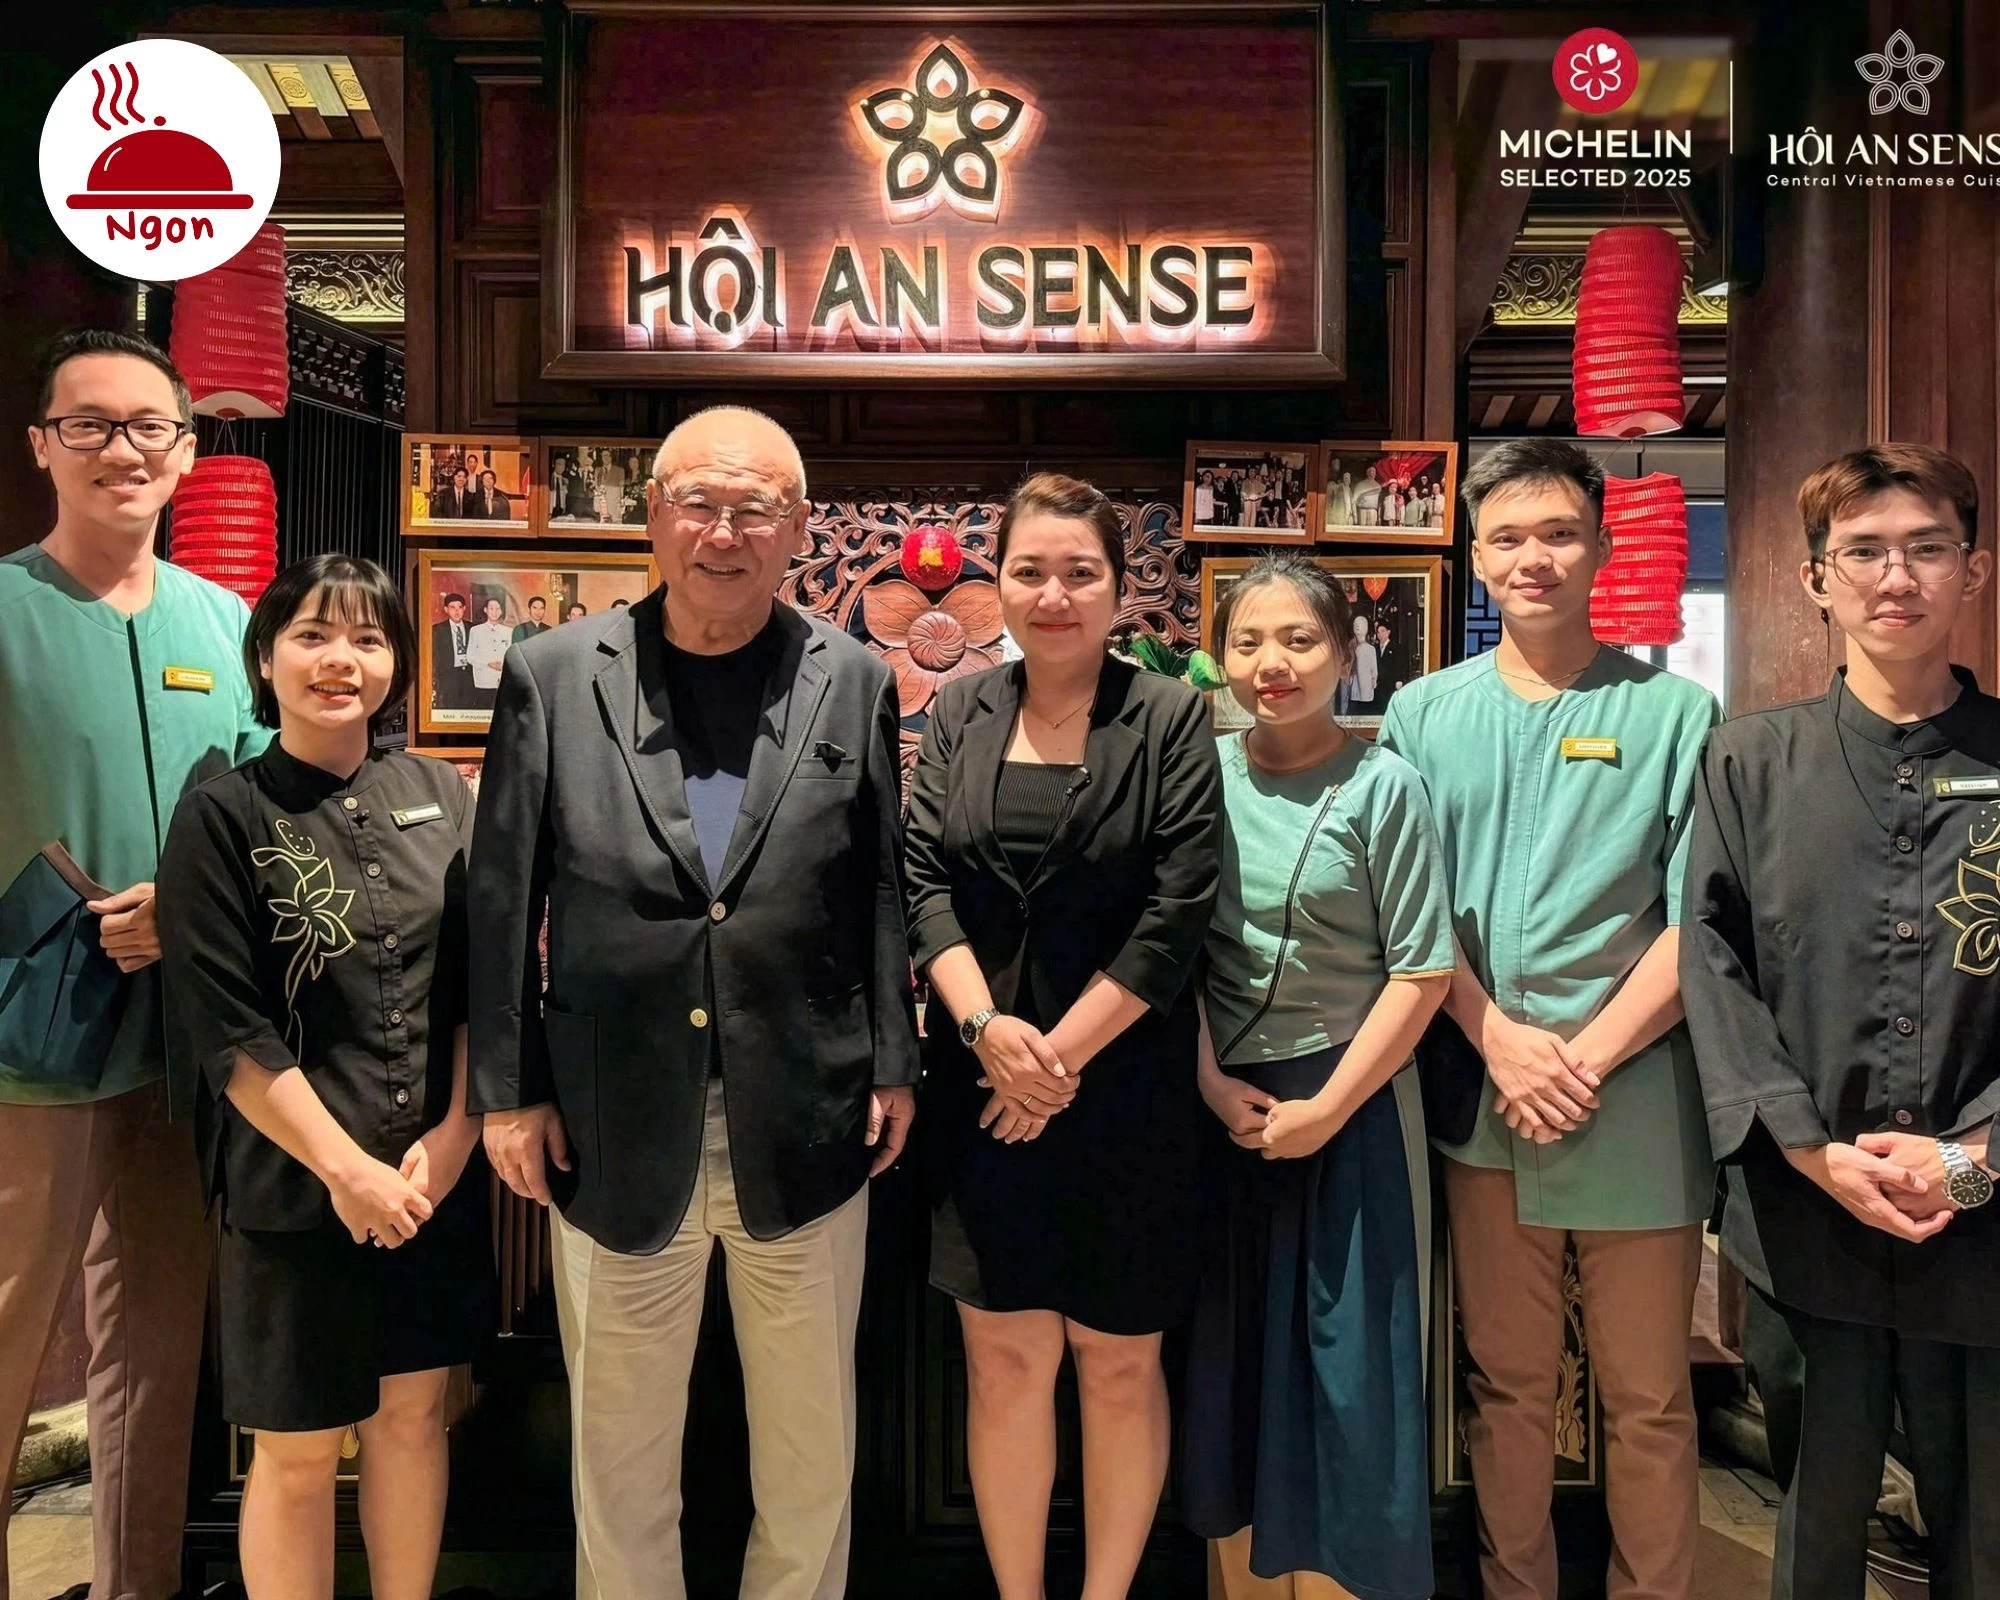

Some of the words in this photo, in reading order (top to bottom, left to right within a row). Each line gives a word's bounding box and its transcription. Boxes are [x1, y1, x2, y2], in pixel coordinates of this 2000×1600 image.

[624, 217, 783, 333] HỘI
[811, 246, 941, 328] AN
[976, 245, 1255, 328] SENSE
